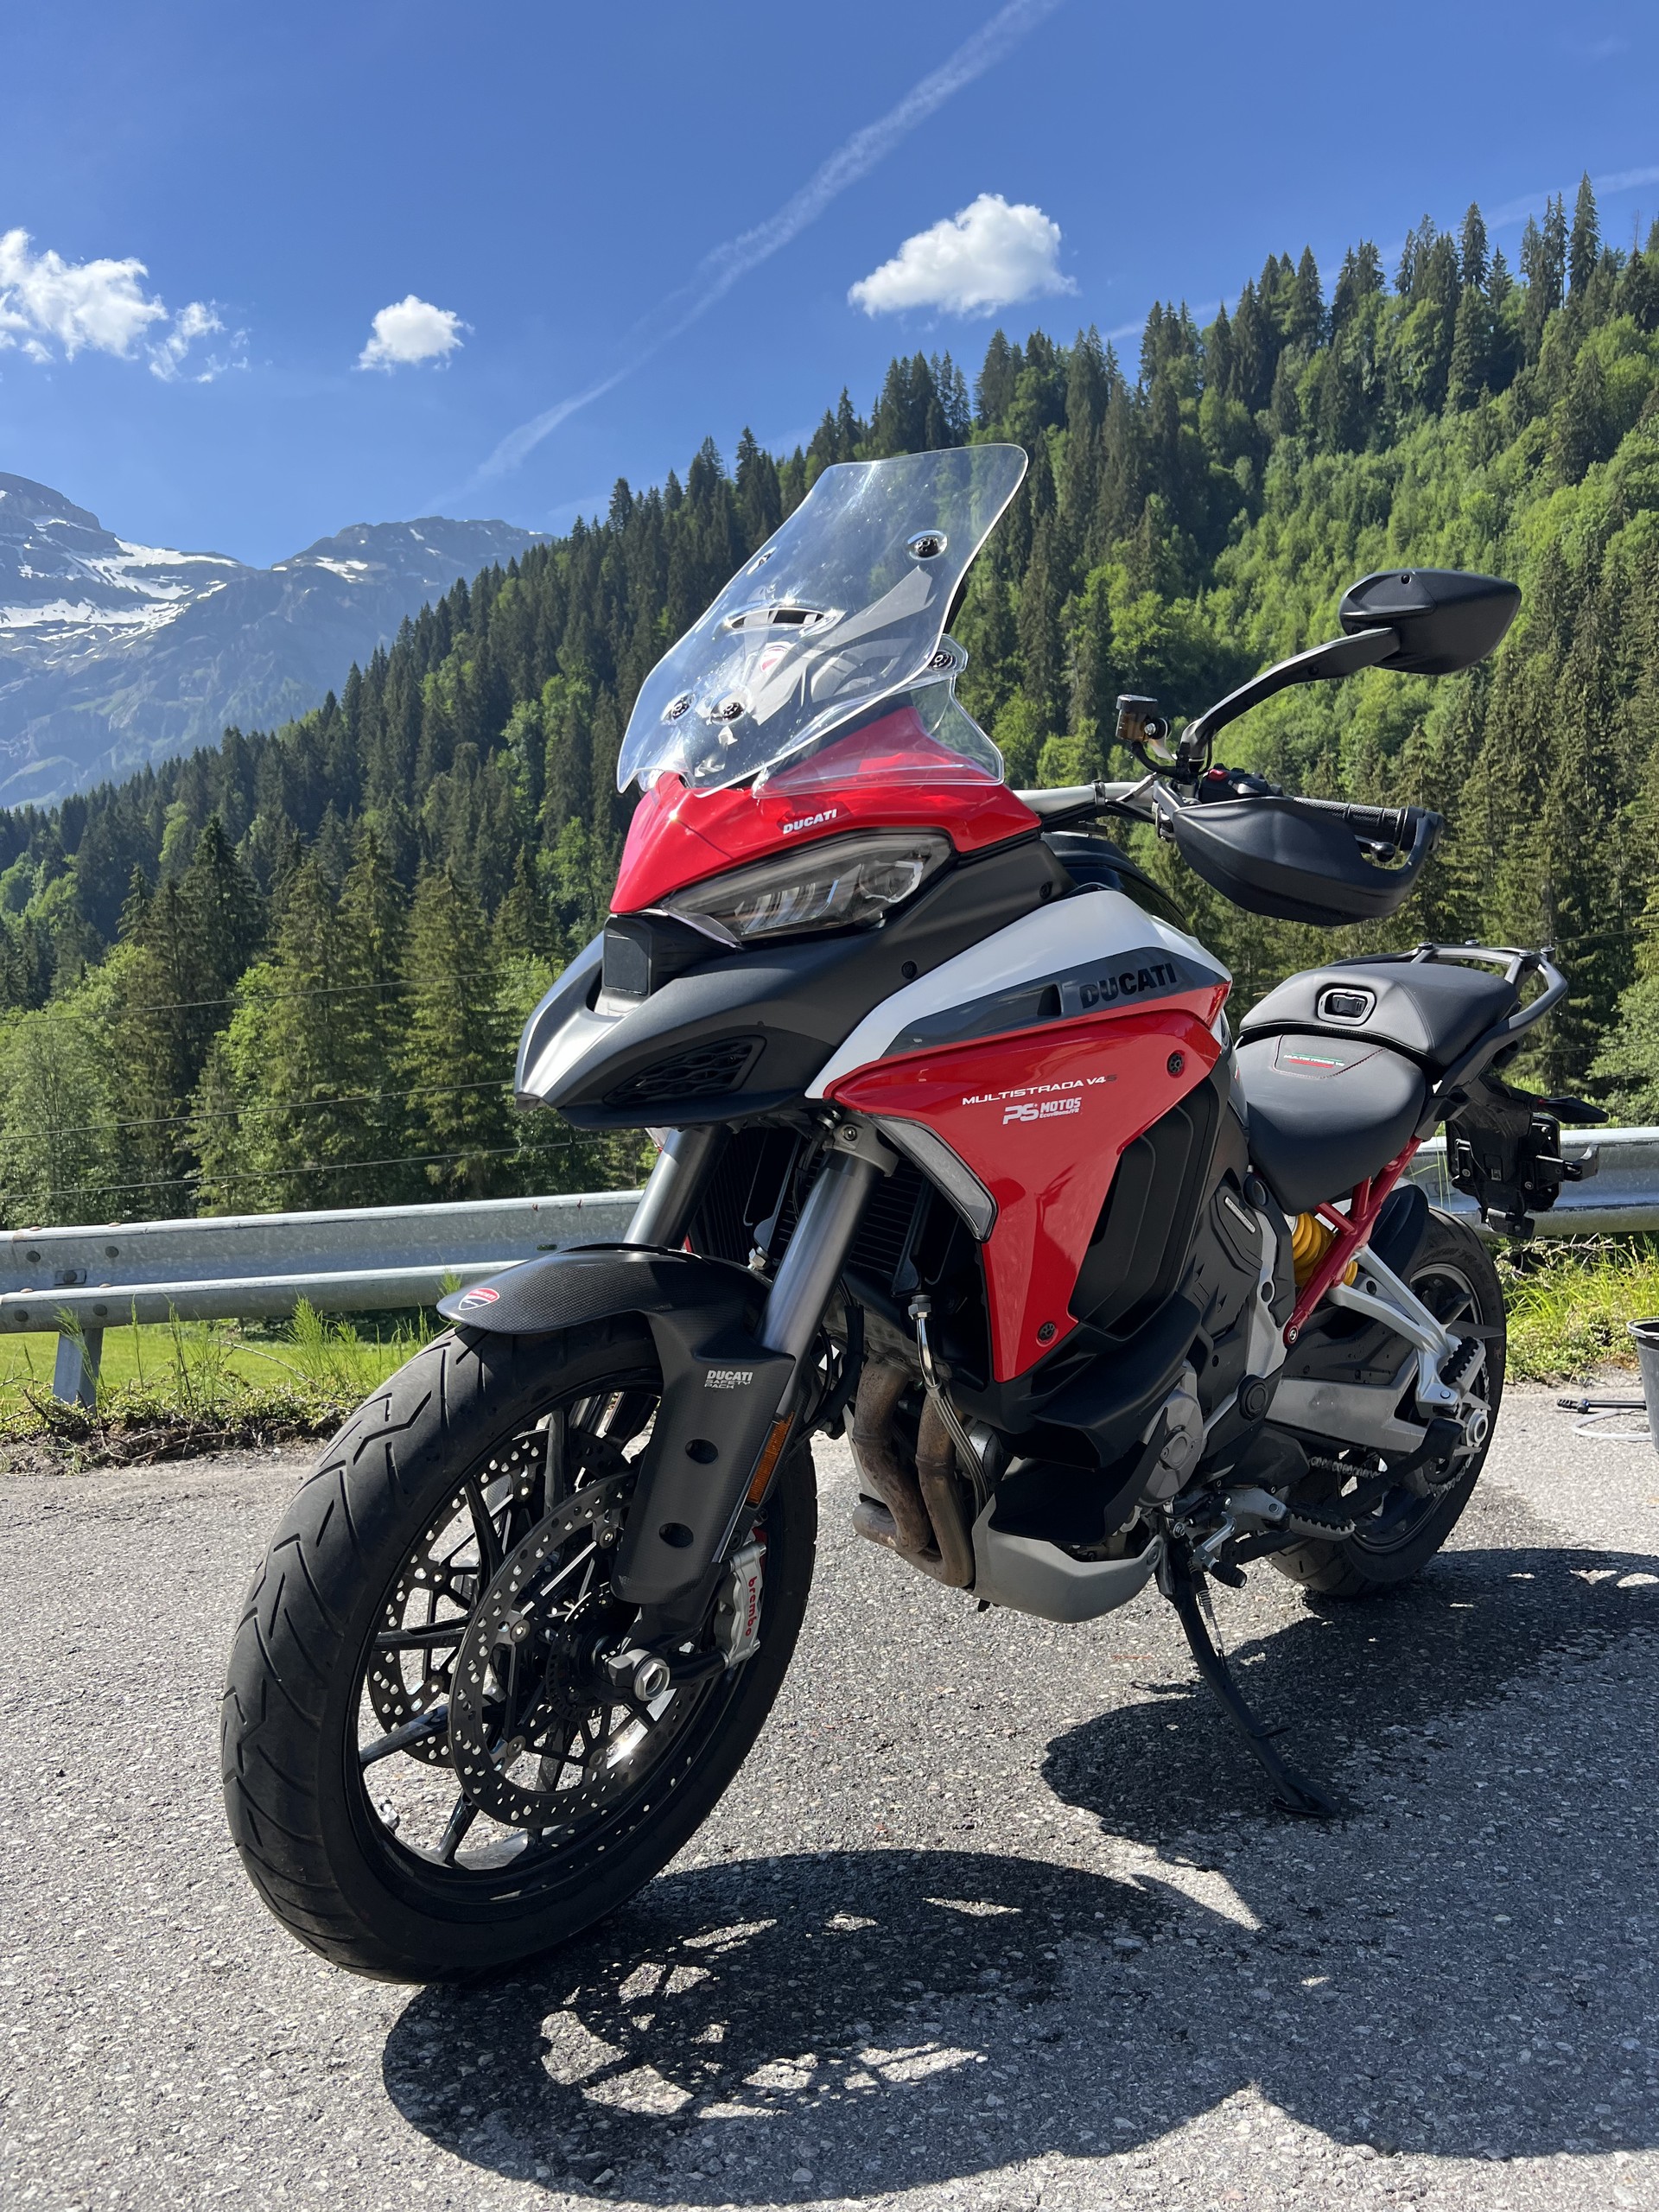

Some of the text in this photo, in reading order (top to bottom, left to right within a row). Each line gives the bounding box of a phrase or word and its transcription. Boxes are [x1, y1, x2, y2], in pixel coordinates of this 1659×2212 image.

[783, 809, 837, 835] DUCATI
[1079, 963, 1177, 1009] DUCATI
[962, 1080, 1084, 1105] MULTISTRADA
[1039, 1097, 1082, 1113] MOTOS
[707, 1370, 753, 1381] DUCATI
[746, 1576, 758, 1637] brembo
